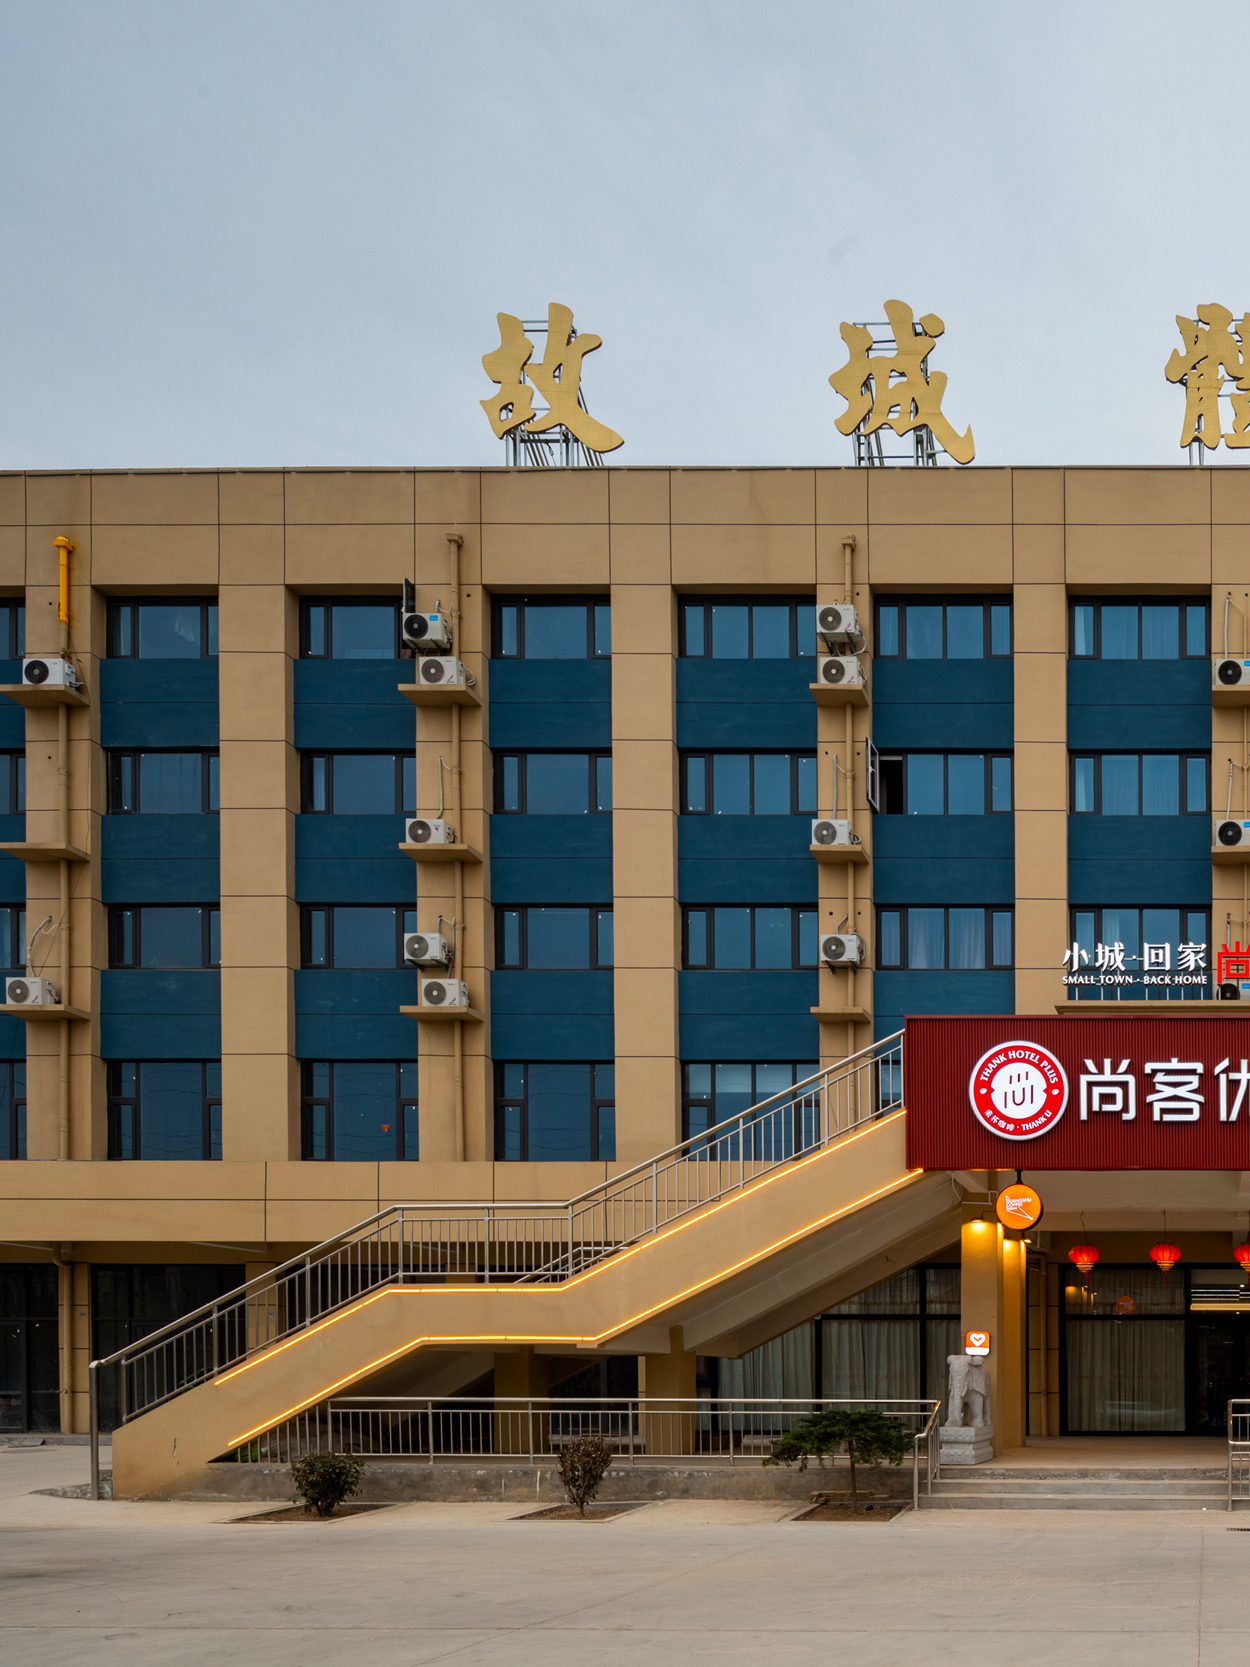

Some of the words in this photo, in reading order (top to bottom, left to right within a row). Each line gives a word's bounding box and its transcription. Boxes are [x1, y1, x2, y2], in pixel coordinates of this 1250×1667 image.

[1062, 975, 1096, 985] SMALL
[1099, 975, 1133, 985] TOWN
[1143, 975, 1172, 985] BACK
[1175, 975, 1207, 985] HOME
[980, 1053, 1008, 1082] THANK
[1007, 1049, 1040, 1064] HOTEL
[1040, 1060, 1059, 1084] PLUS
[1021, 1115, 1048, 1131] THANK
[1044, 1109, 1053, 1118] U
